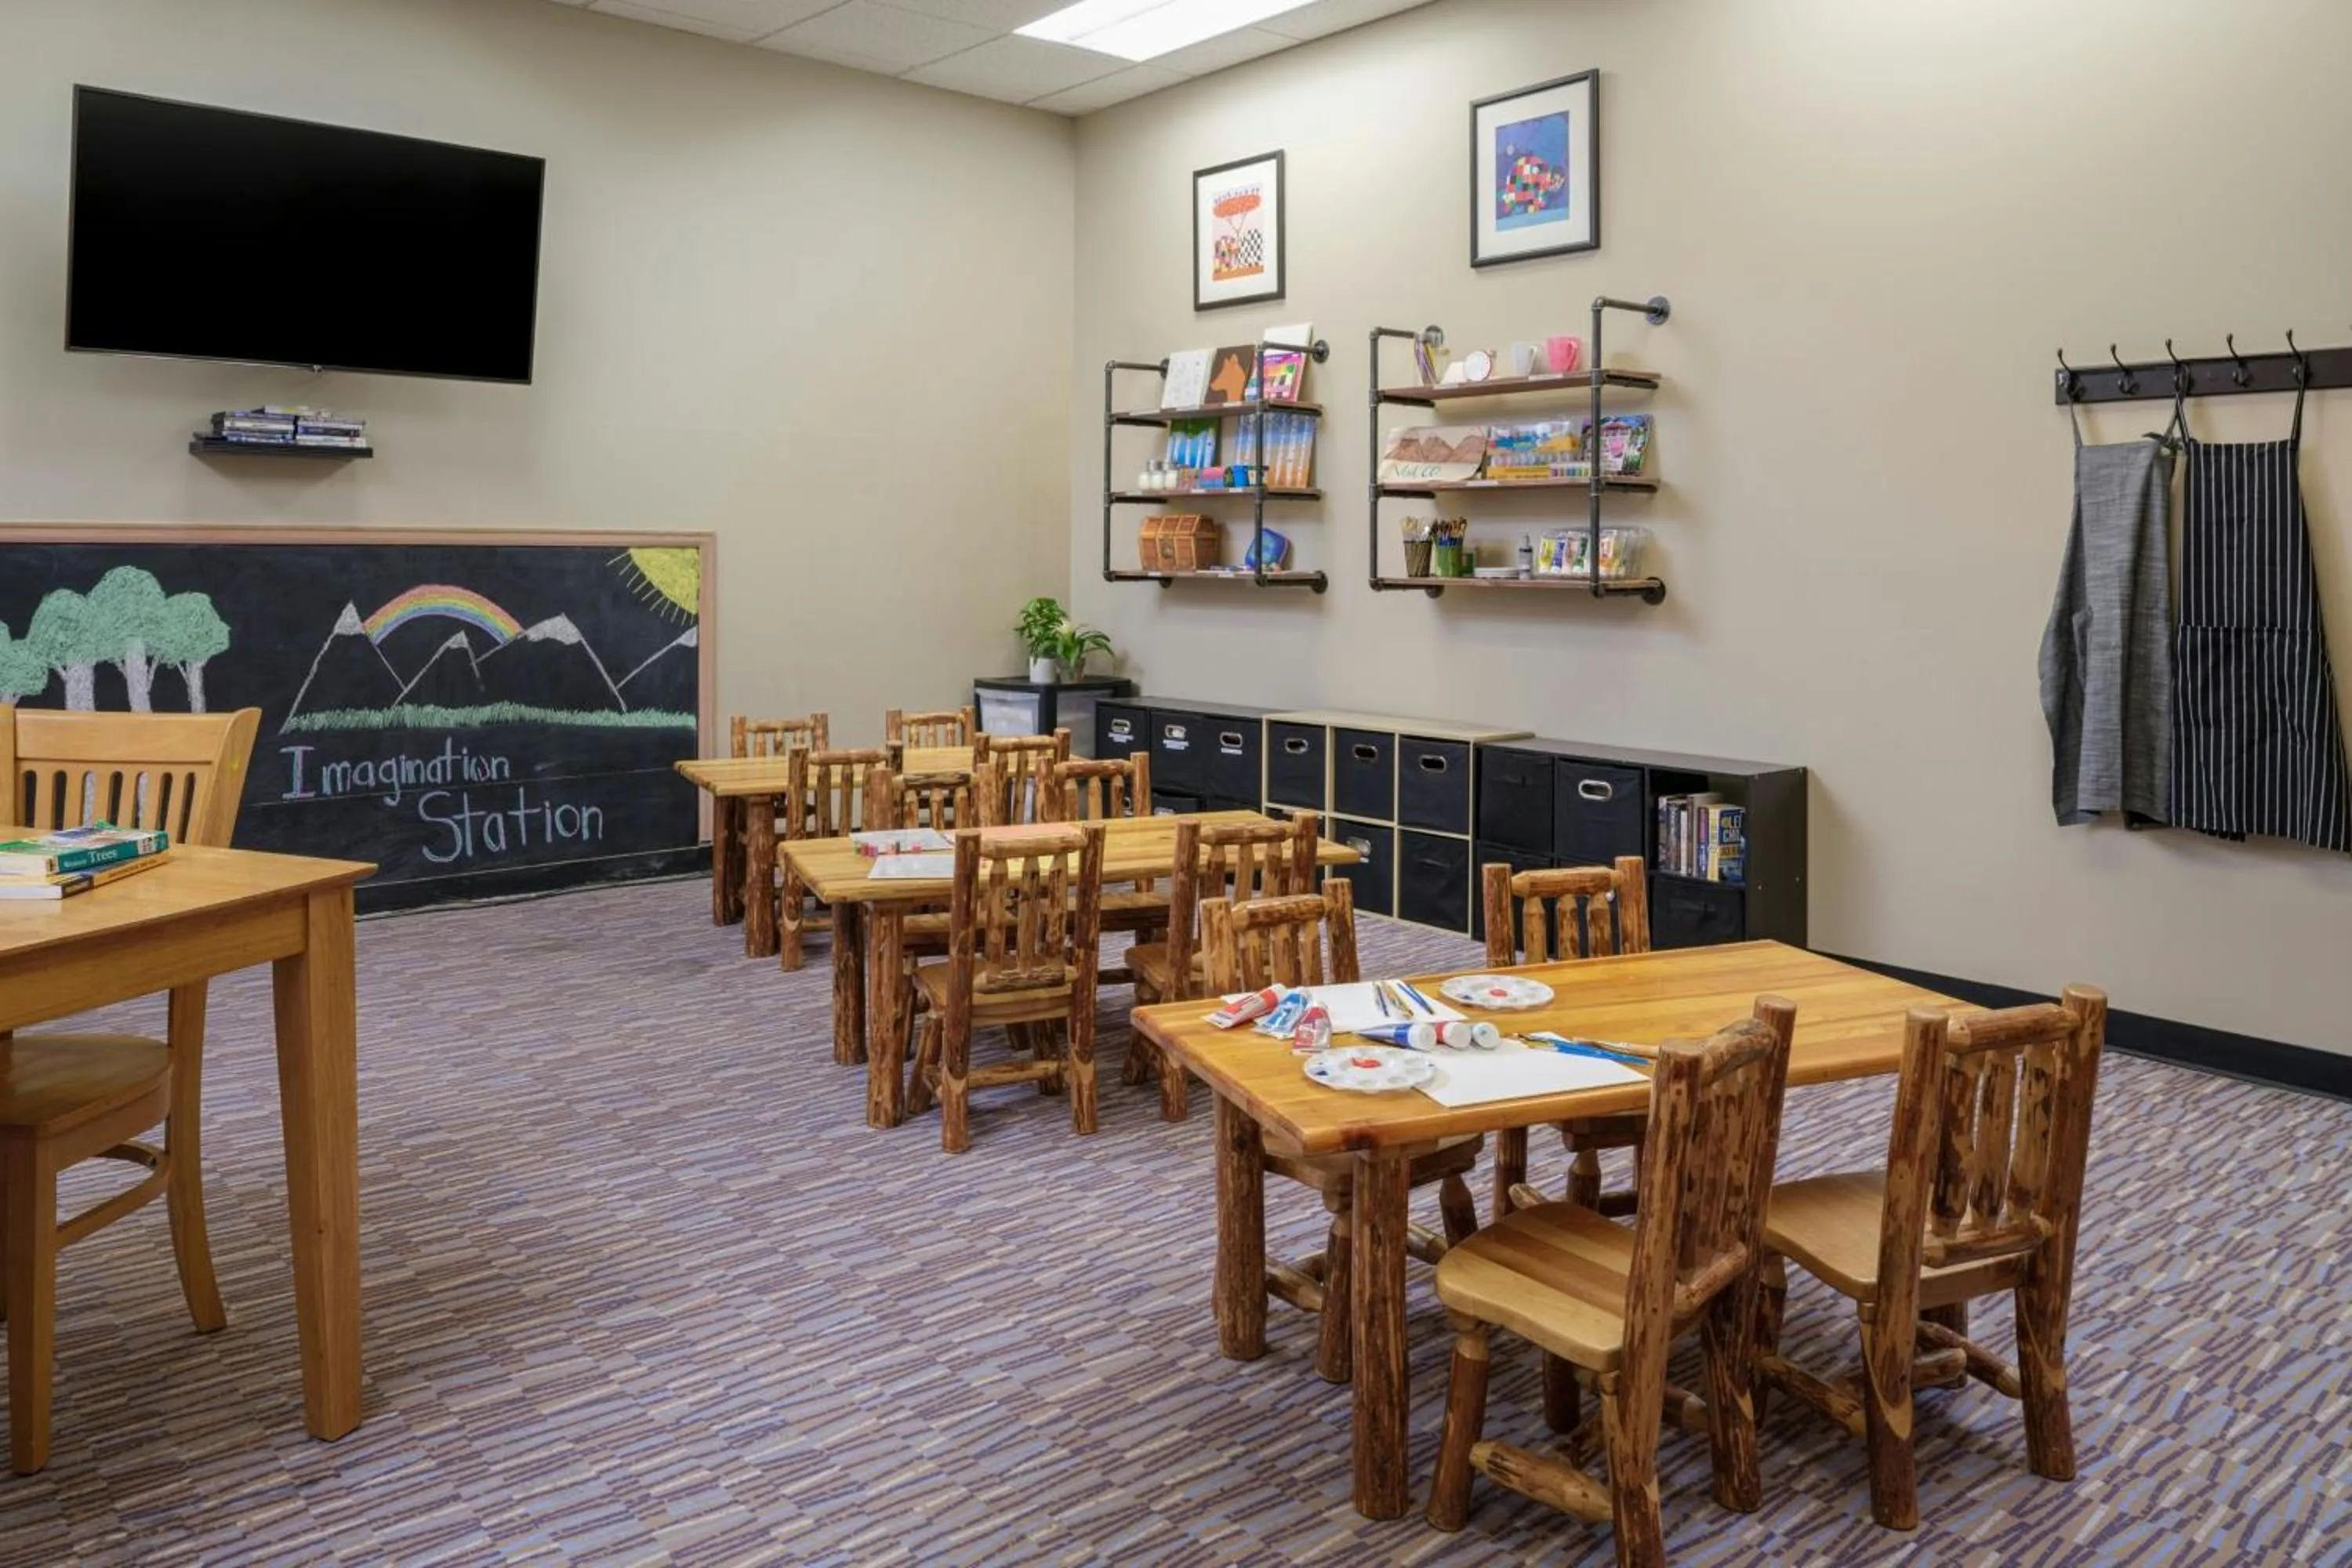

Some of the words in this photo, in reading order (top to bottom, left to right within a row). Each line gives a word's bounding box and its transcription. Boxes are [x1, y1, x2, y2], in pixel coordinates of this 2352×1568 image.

[279, 736, 510, 807] Imagination
[87, 849, 118, 863] Trees
[418, 786, 603, 863] Station
